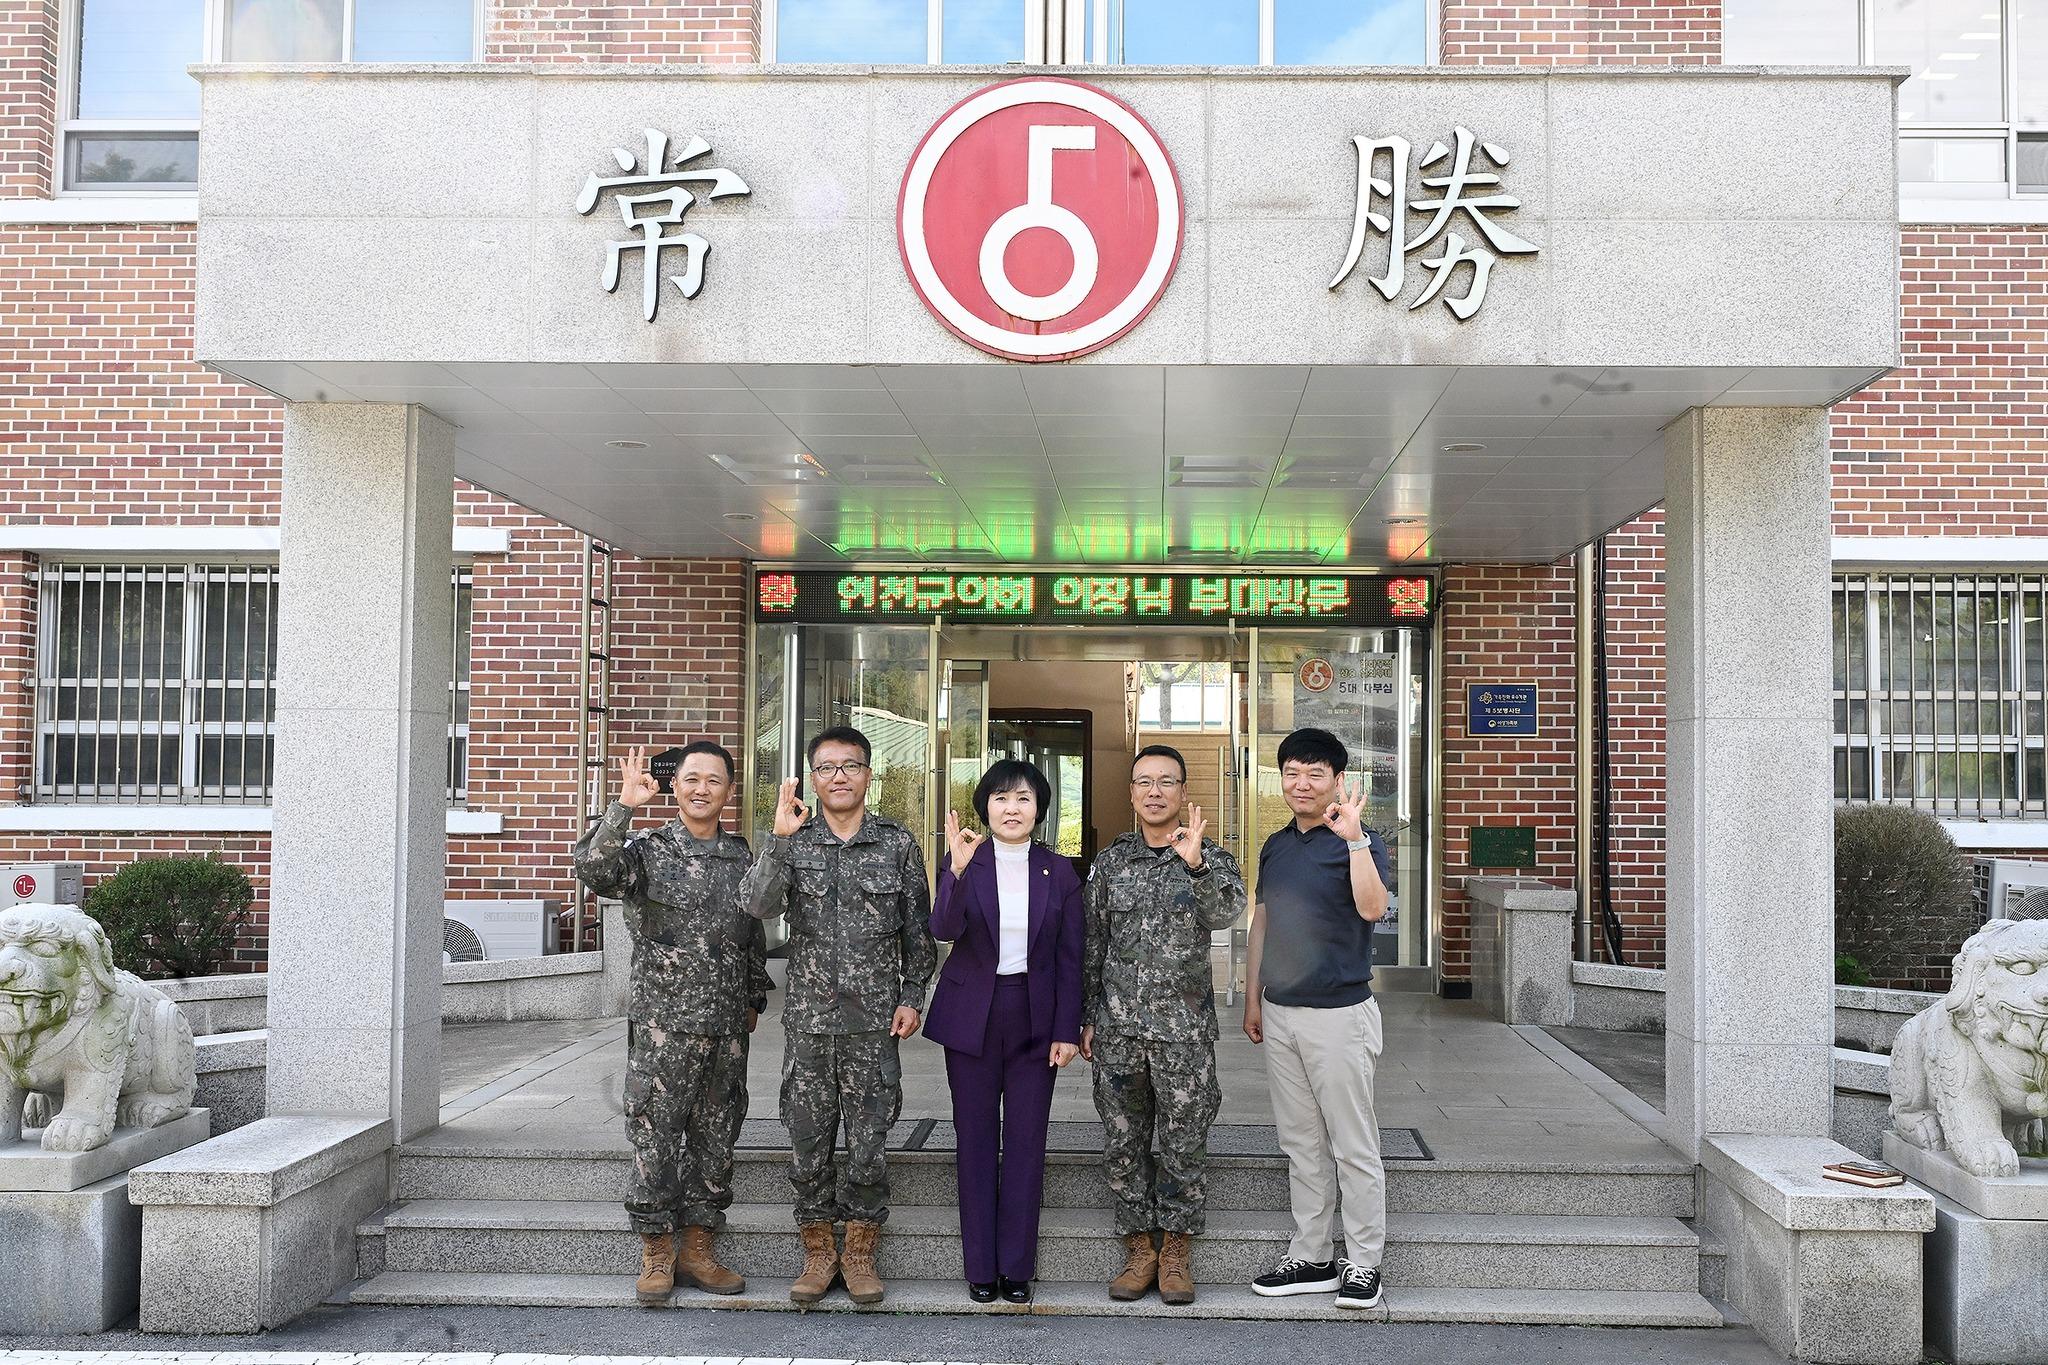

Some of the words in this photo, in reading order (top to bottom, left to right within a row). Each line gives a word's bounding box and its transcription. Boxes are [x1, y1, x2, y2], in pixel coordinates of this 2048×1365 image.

[576, 128, 751, 321] 常
[1329, 127, 1539, 321] 勝
[1189, 578, 1350, 617] 부대방문
[1339, 681, 1357, 694] 5대
[13, 874, 37, 899] LG
